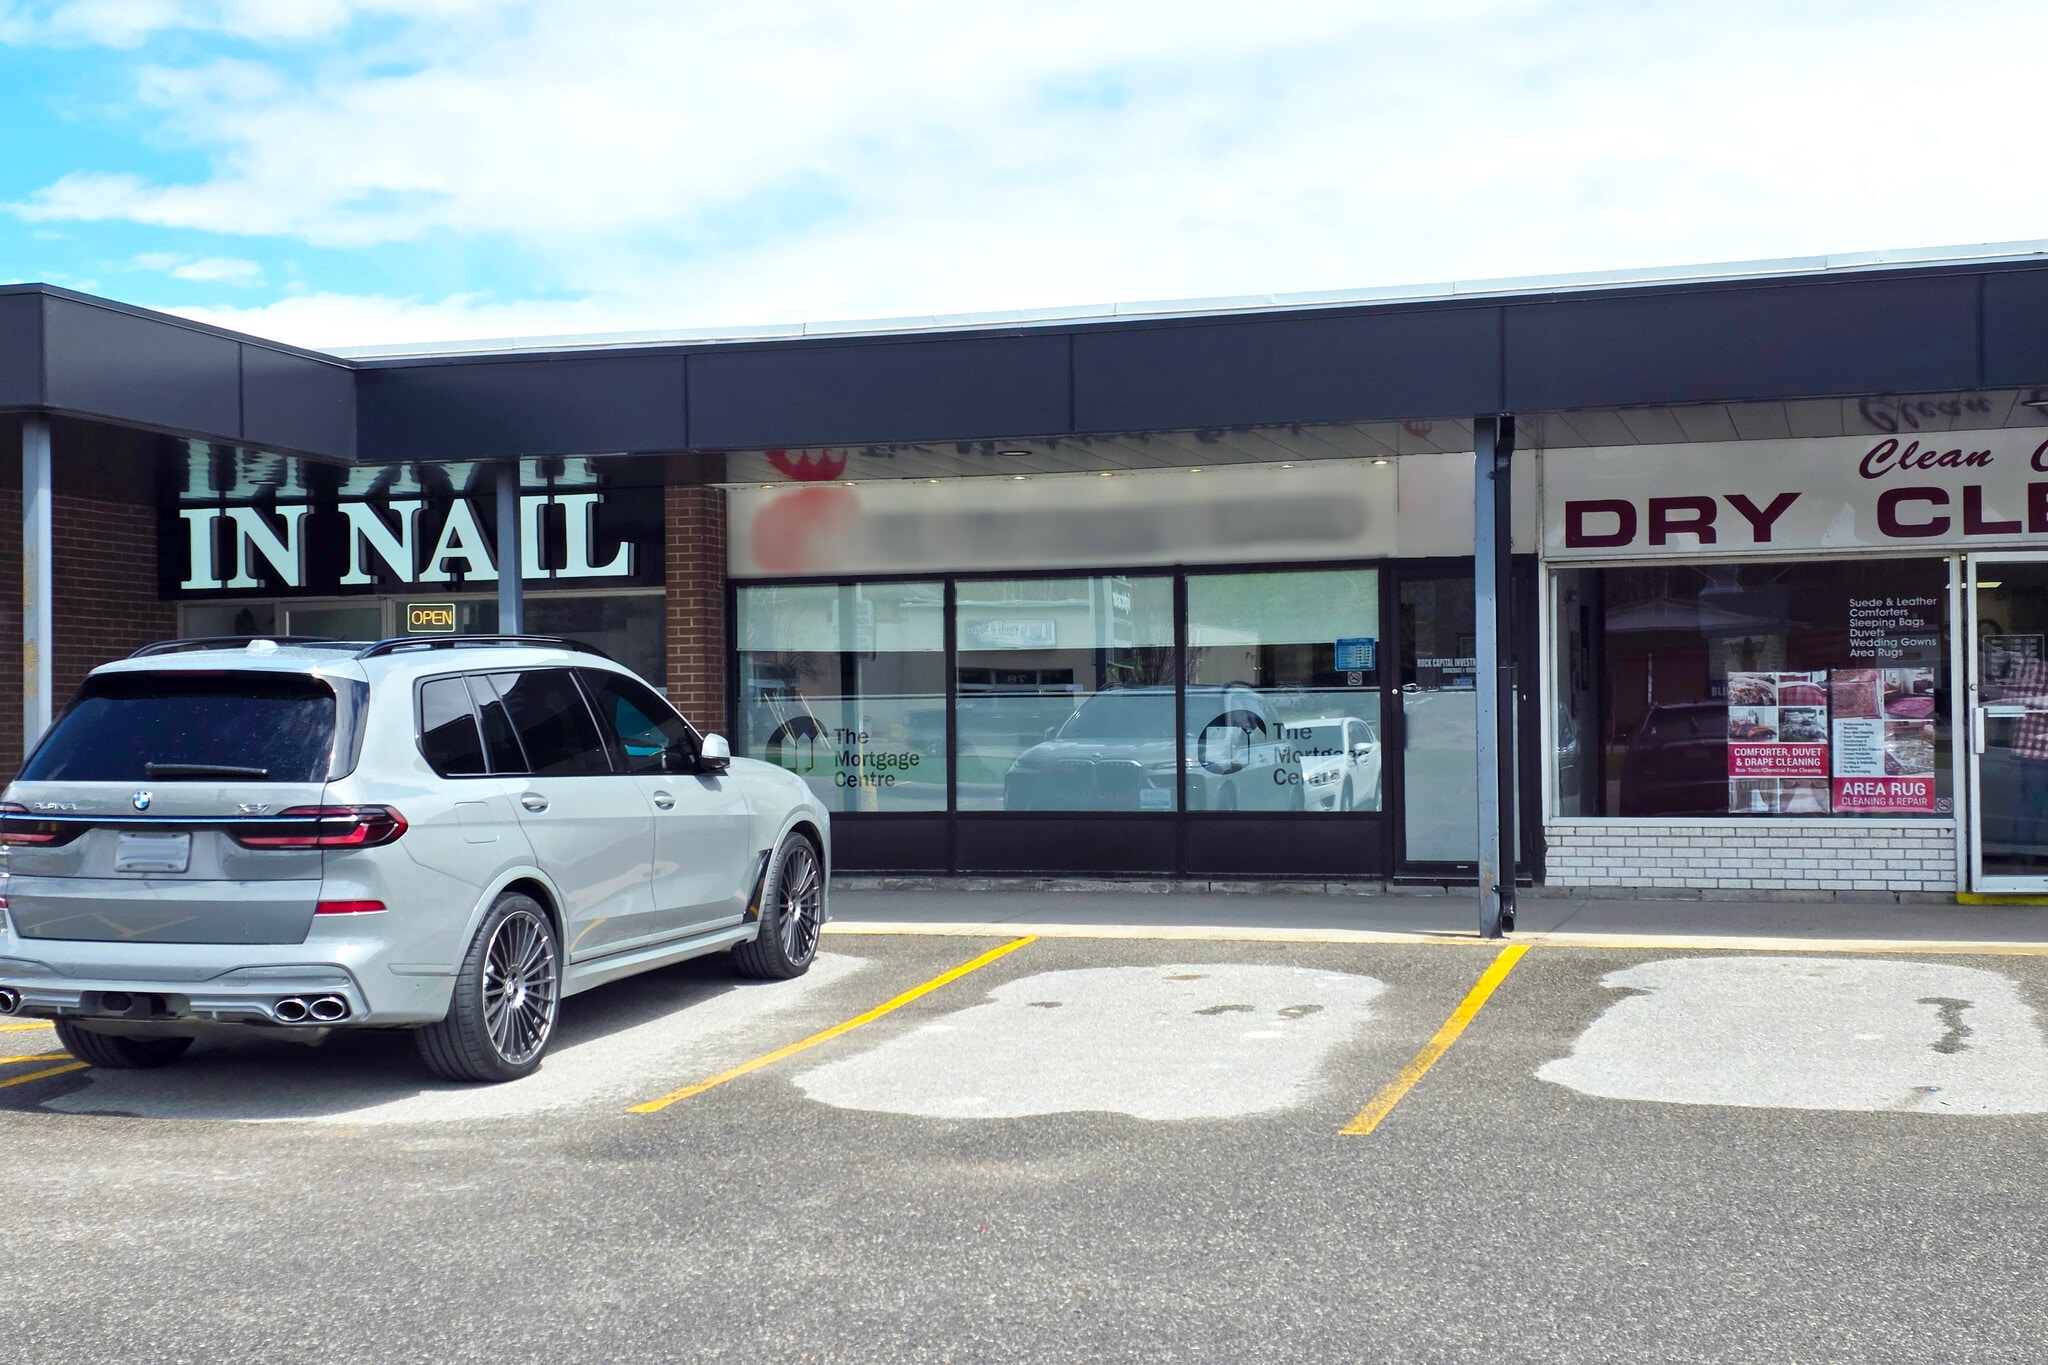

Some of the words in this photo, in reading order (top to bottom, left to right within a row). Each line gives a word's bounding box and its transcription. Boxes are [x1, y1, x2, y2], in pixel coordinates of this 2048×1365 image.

[1859, 438, 1994, 479] Clean
[1564, 492, 1802, 548] DRY
[180, 504, 309, 590] IN
[338, 493, 632, 585] NAIL
[1849, 599, 1883, 608] Suede
[1885, 597, 1894, 606] &
[1896, 597, 1937, 606] Leather
[411, 610, 452, 625] OPEN
[1849, 608, 1909, 617] Comforters
[1849, 618, 1896, 628] Sleeping
[1899, 618, 1925, 628] Bags
[1850, 628, 1885, 637] Duvets
[1850, 638, 1898, 648] Wedding
[1900, 637, 1937, 646] Gowns
[1850, 648, 1875, 657] Area
[1878, 648, 1904, 659] Rugs
[1417, 659, 1432, 668] ROCK
[1432, 658, 1454, 667] CAPITAL
[833, 728, 869, 745] The
[1734, 748, 1790, 757] COMFORTER,
[1792, 748, 1822, 756] DUVET
[834, 750, 920, 770] Mortgage
[1736, 758, 1742, 766] &
[1744, 758, 1774, 766] DRAPE
[1776, 758, 1821, 766] CLEANING
[834, 771, 896, 788] Centre
[1842, 782, 1886, 796] AREA
[1891, 782, 1926, 796] RUG
[1841, 797, 1886, 806] CLEANING
[1888, 798, 1894, 806] &
[1896, 797, 1928, 806] REPAIR
